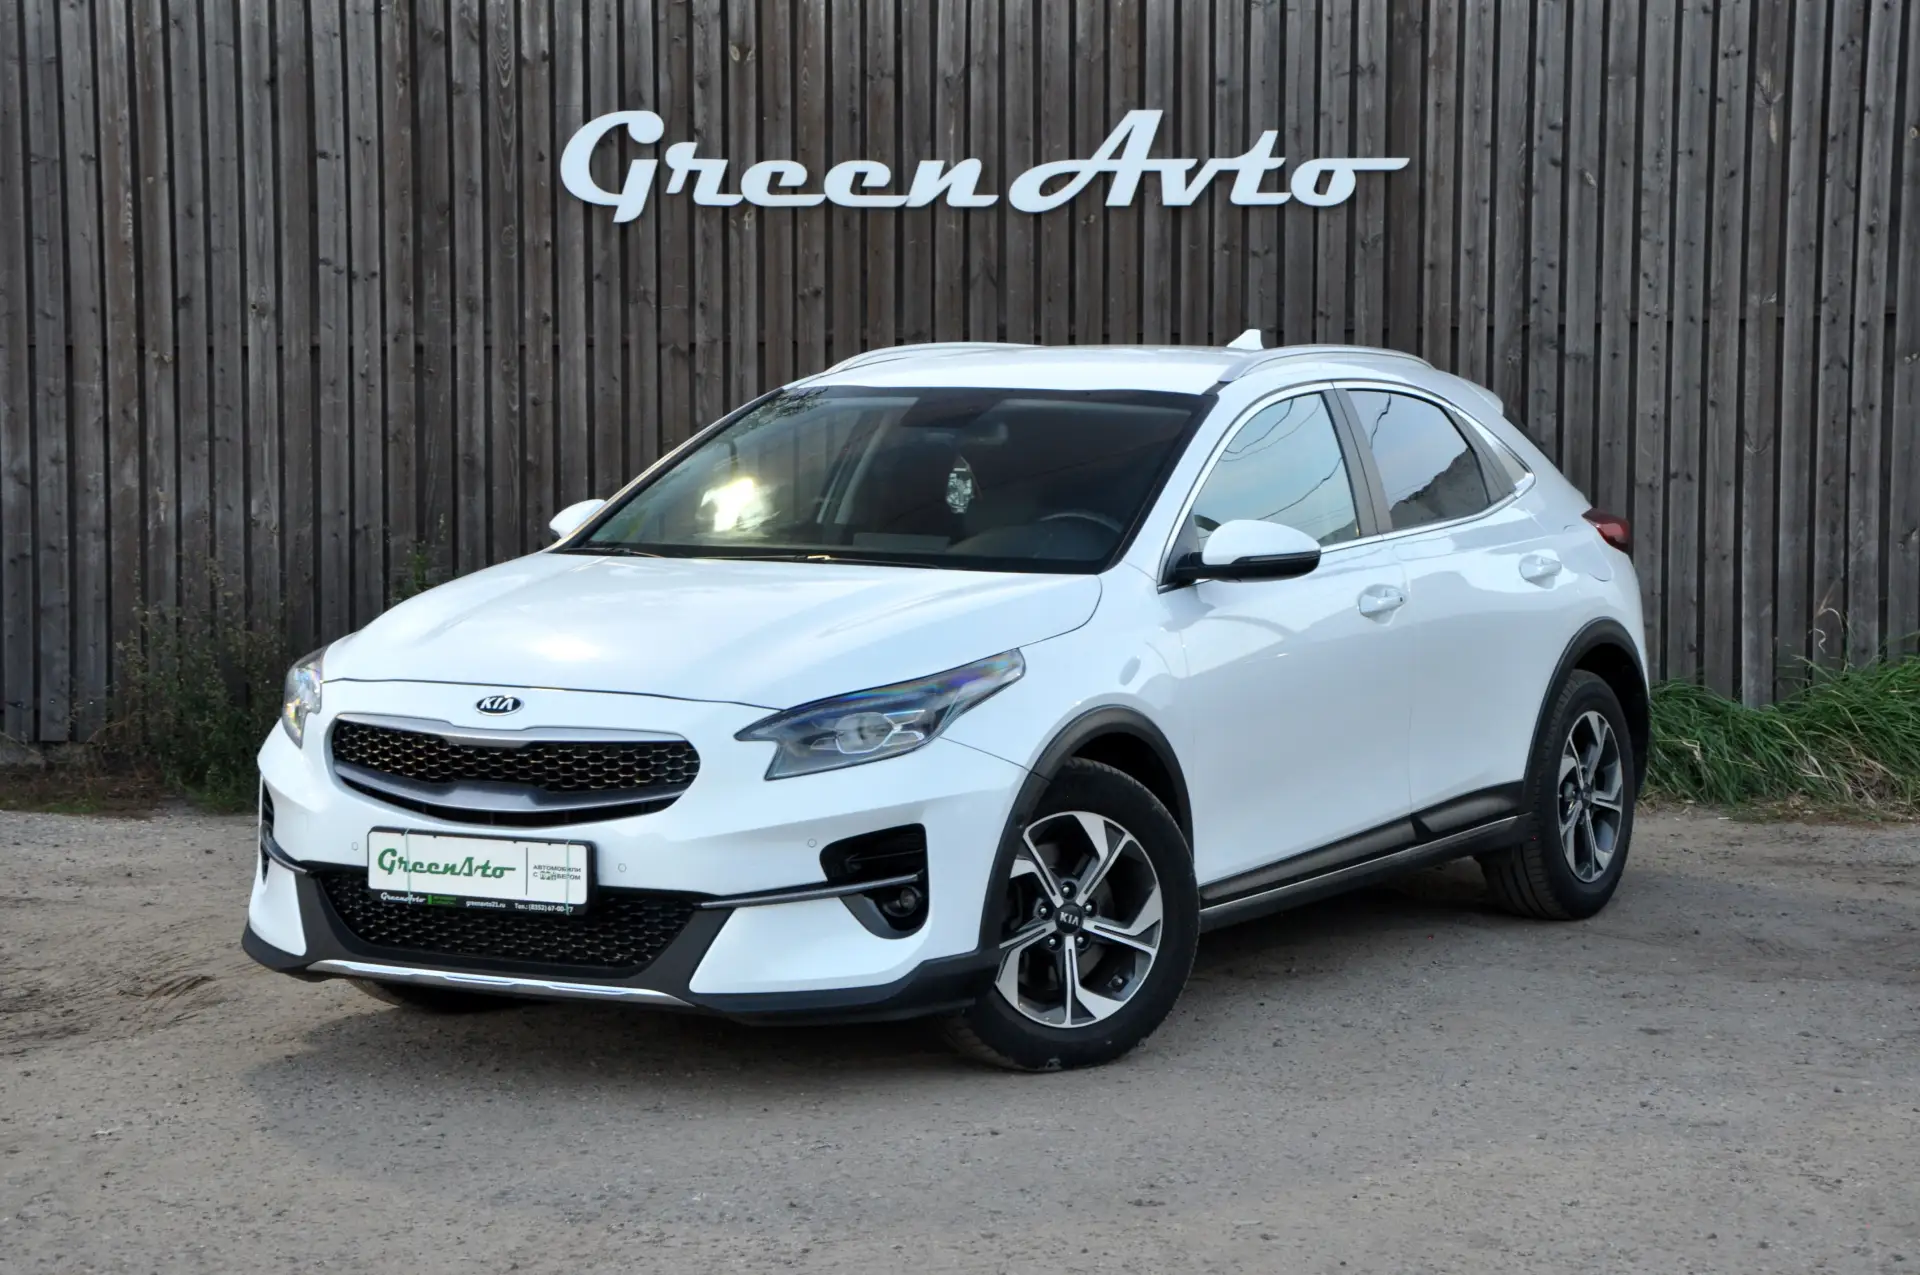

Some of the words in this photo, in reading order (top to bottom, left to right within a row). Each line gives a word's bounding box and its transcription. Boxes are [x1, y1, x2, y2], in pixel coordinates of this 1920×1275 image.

[560, 109, 1000, 223] Green
[1008, 109, 1411, 213] Avto
[479, 697, 514, 710] KIA
[1061, 911, 1079, 926] KIA
